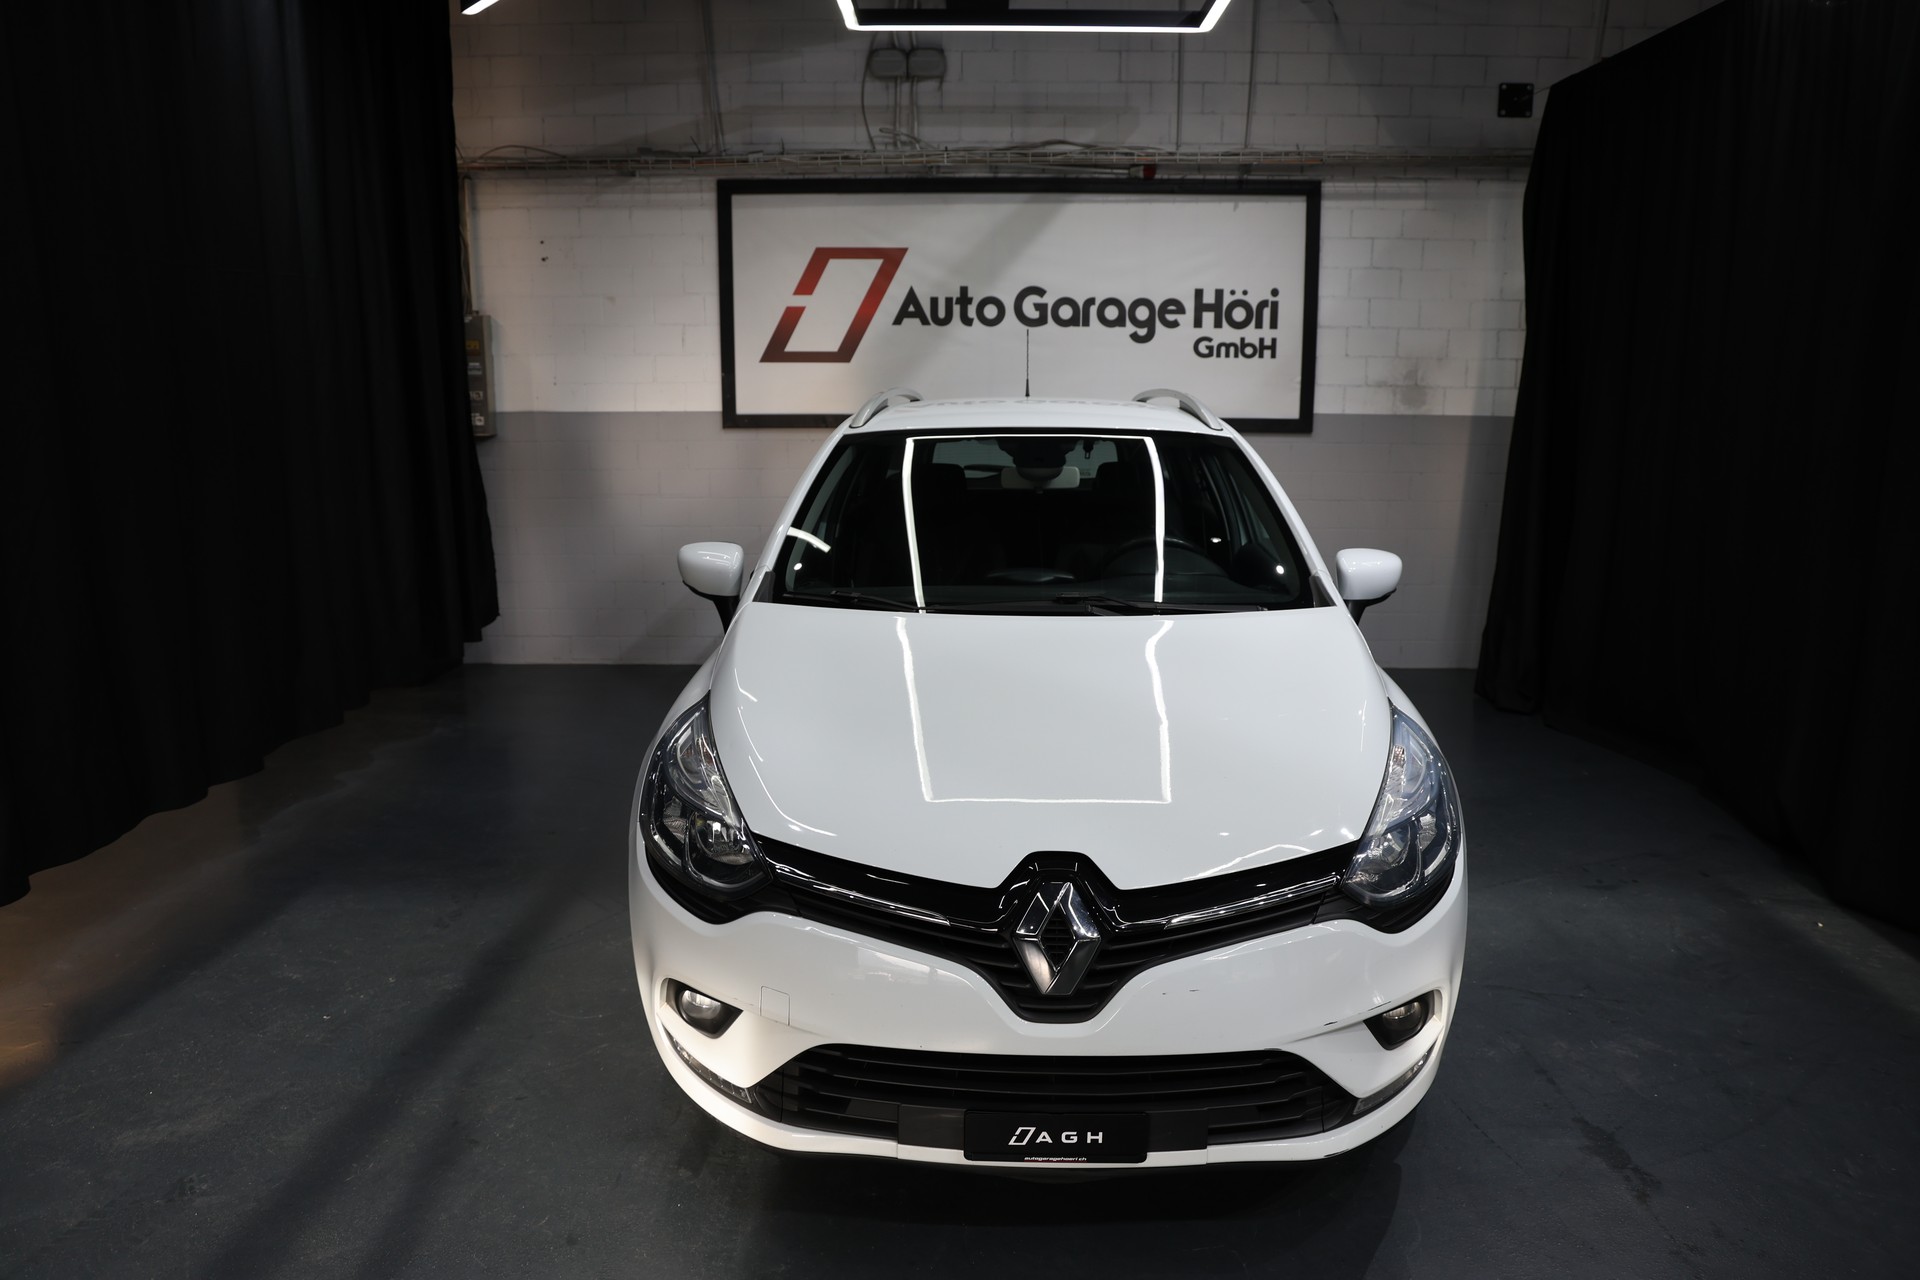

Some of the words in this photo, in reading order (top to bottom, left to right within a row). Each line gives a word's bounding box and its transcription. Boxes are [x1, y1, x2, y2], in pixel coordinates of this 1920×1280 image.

[891, 285, 1006, 327] Auto
[1013, 285, 1186, 344] Garage
[1193, 288, 1280, 330] Höri
[1193, 336, 1277, 359] GmbH
[1035, 1131, 1103, 1144] AGH
